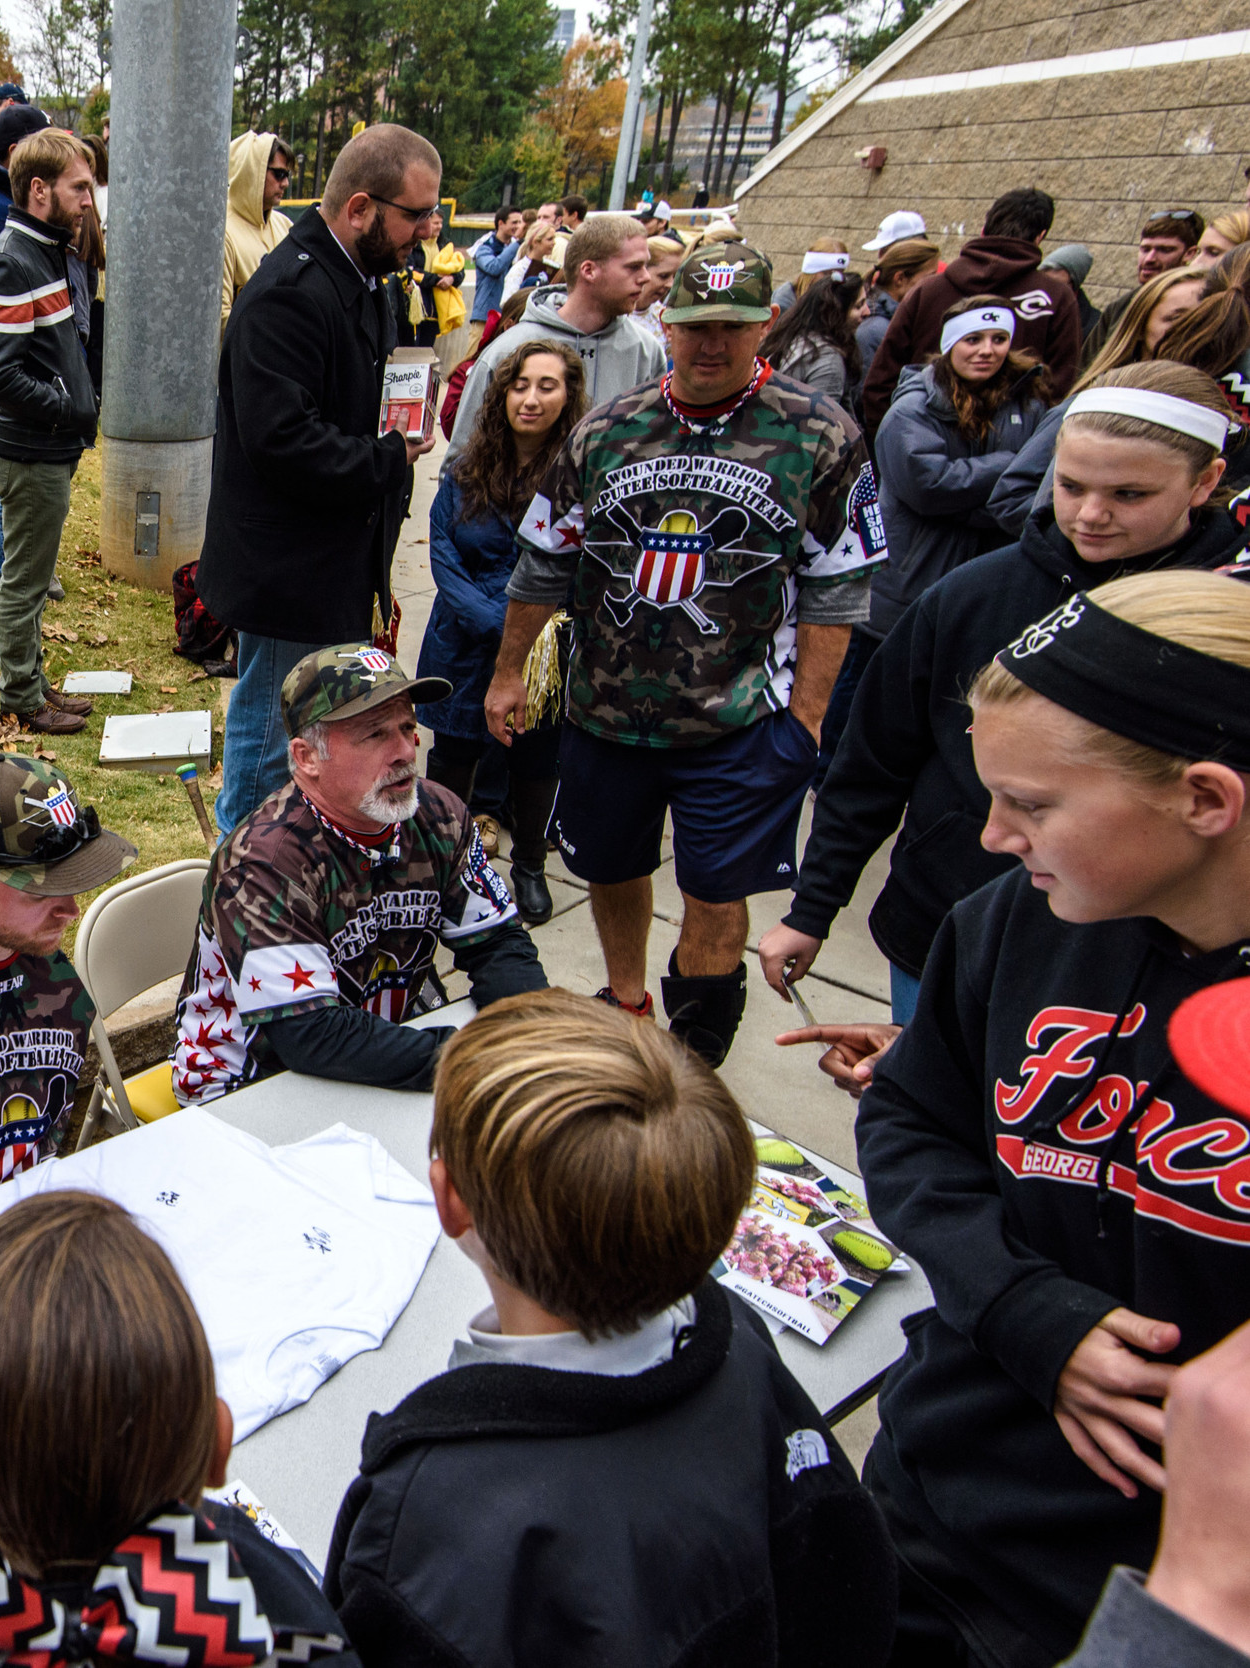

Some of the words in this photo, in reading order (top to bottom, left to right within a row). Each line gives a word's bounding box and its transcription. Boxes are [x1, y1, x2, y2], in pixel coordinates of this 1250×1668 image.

[383, 369, 422, 387] Sharpie
[606, 456, 690, 487] WOUNDED
[692, 456, 771, 492] WARRIOR
[592, 474, 655, 517] PUTEE
[655, 472, 745, 503] SOFTBALL
[744, 487, 797, 532] TEAM
[9, 1029, 74, 1051] WARRIOR
